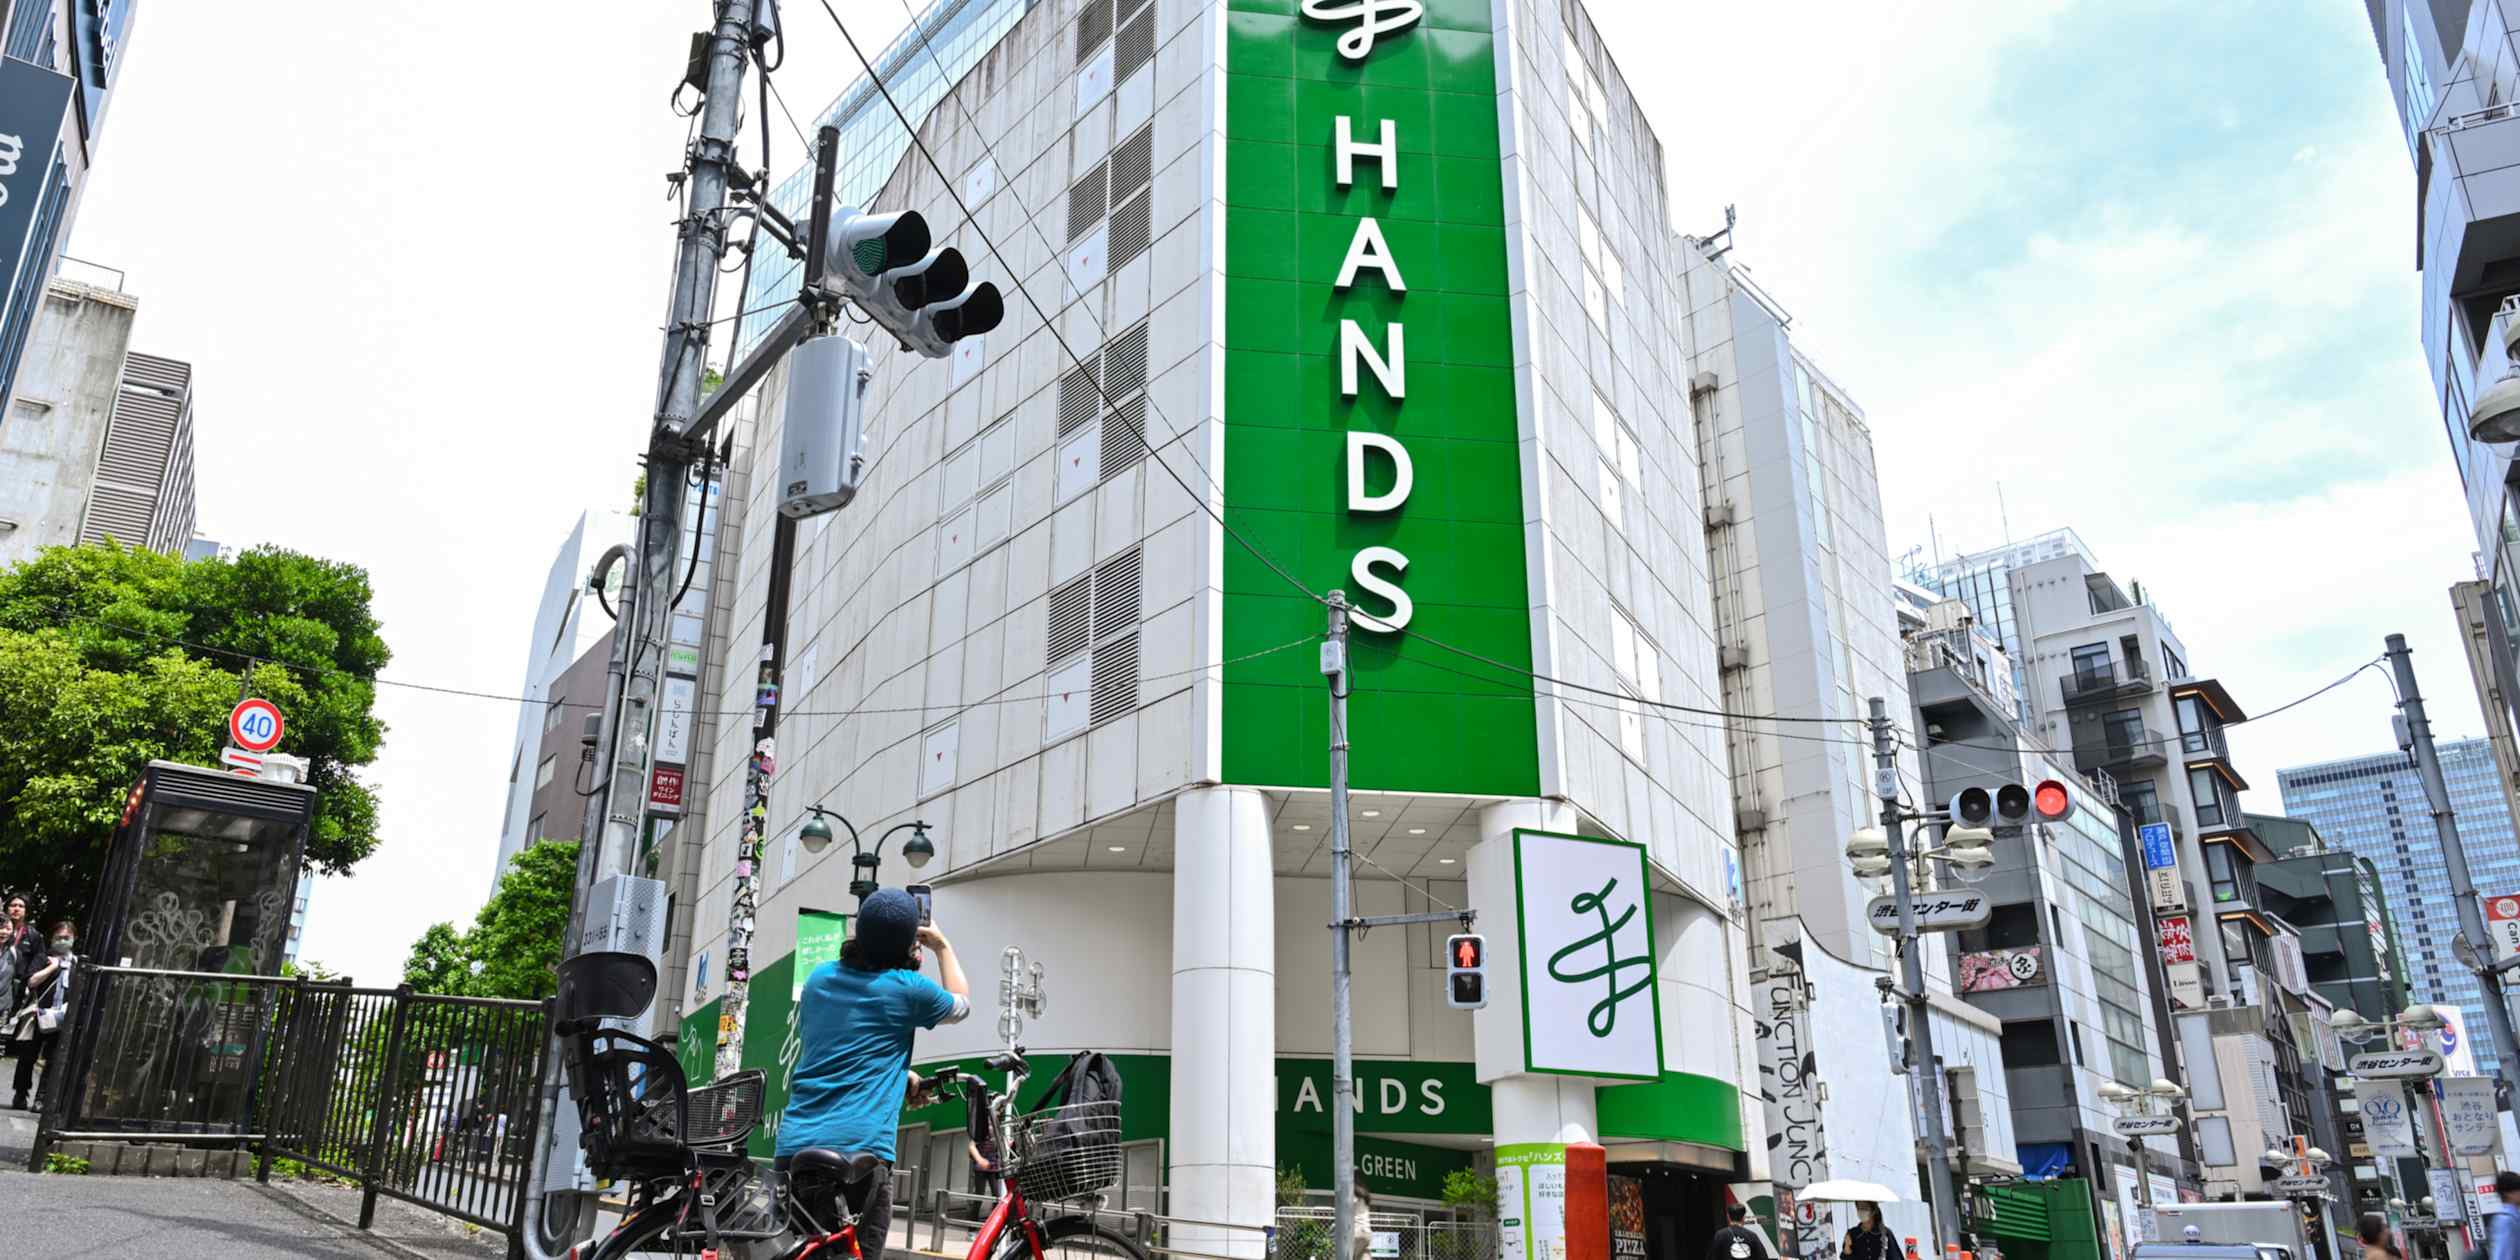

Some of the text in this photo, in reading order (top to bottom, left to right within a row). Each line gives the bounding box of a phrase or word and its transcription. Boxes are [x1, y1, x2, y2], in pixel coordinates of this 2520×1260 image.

[1335, 115, 1414, 633] HANDS
[242, 713, 273, 738] 40
[2356, 1055, 2434, 1071] 渋谷センター街
[2117, 1119, 2174, 1129] 渋谷センター街
